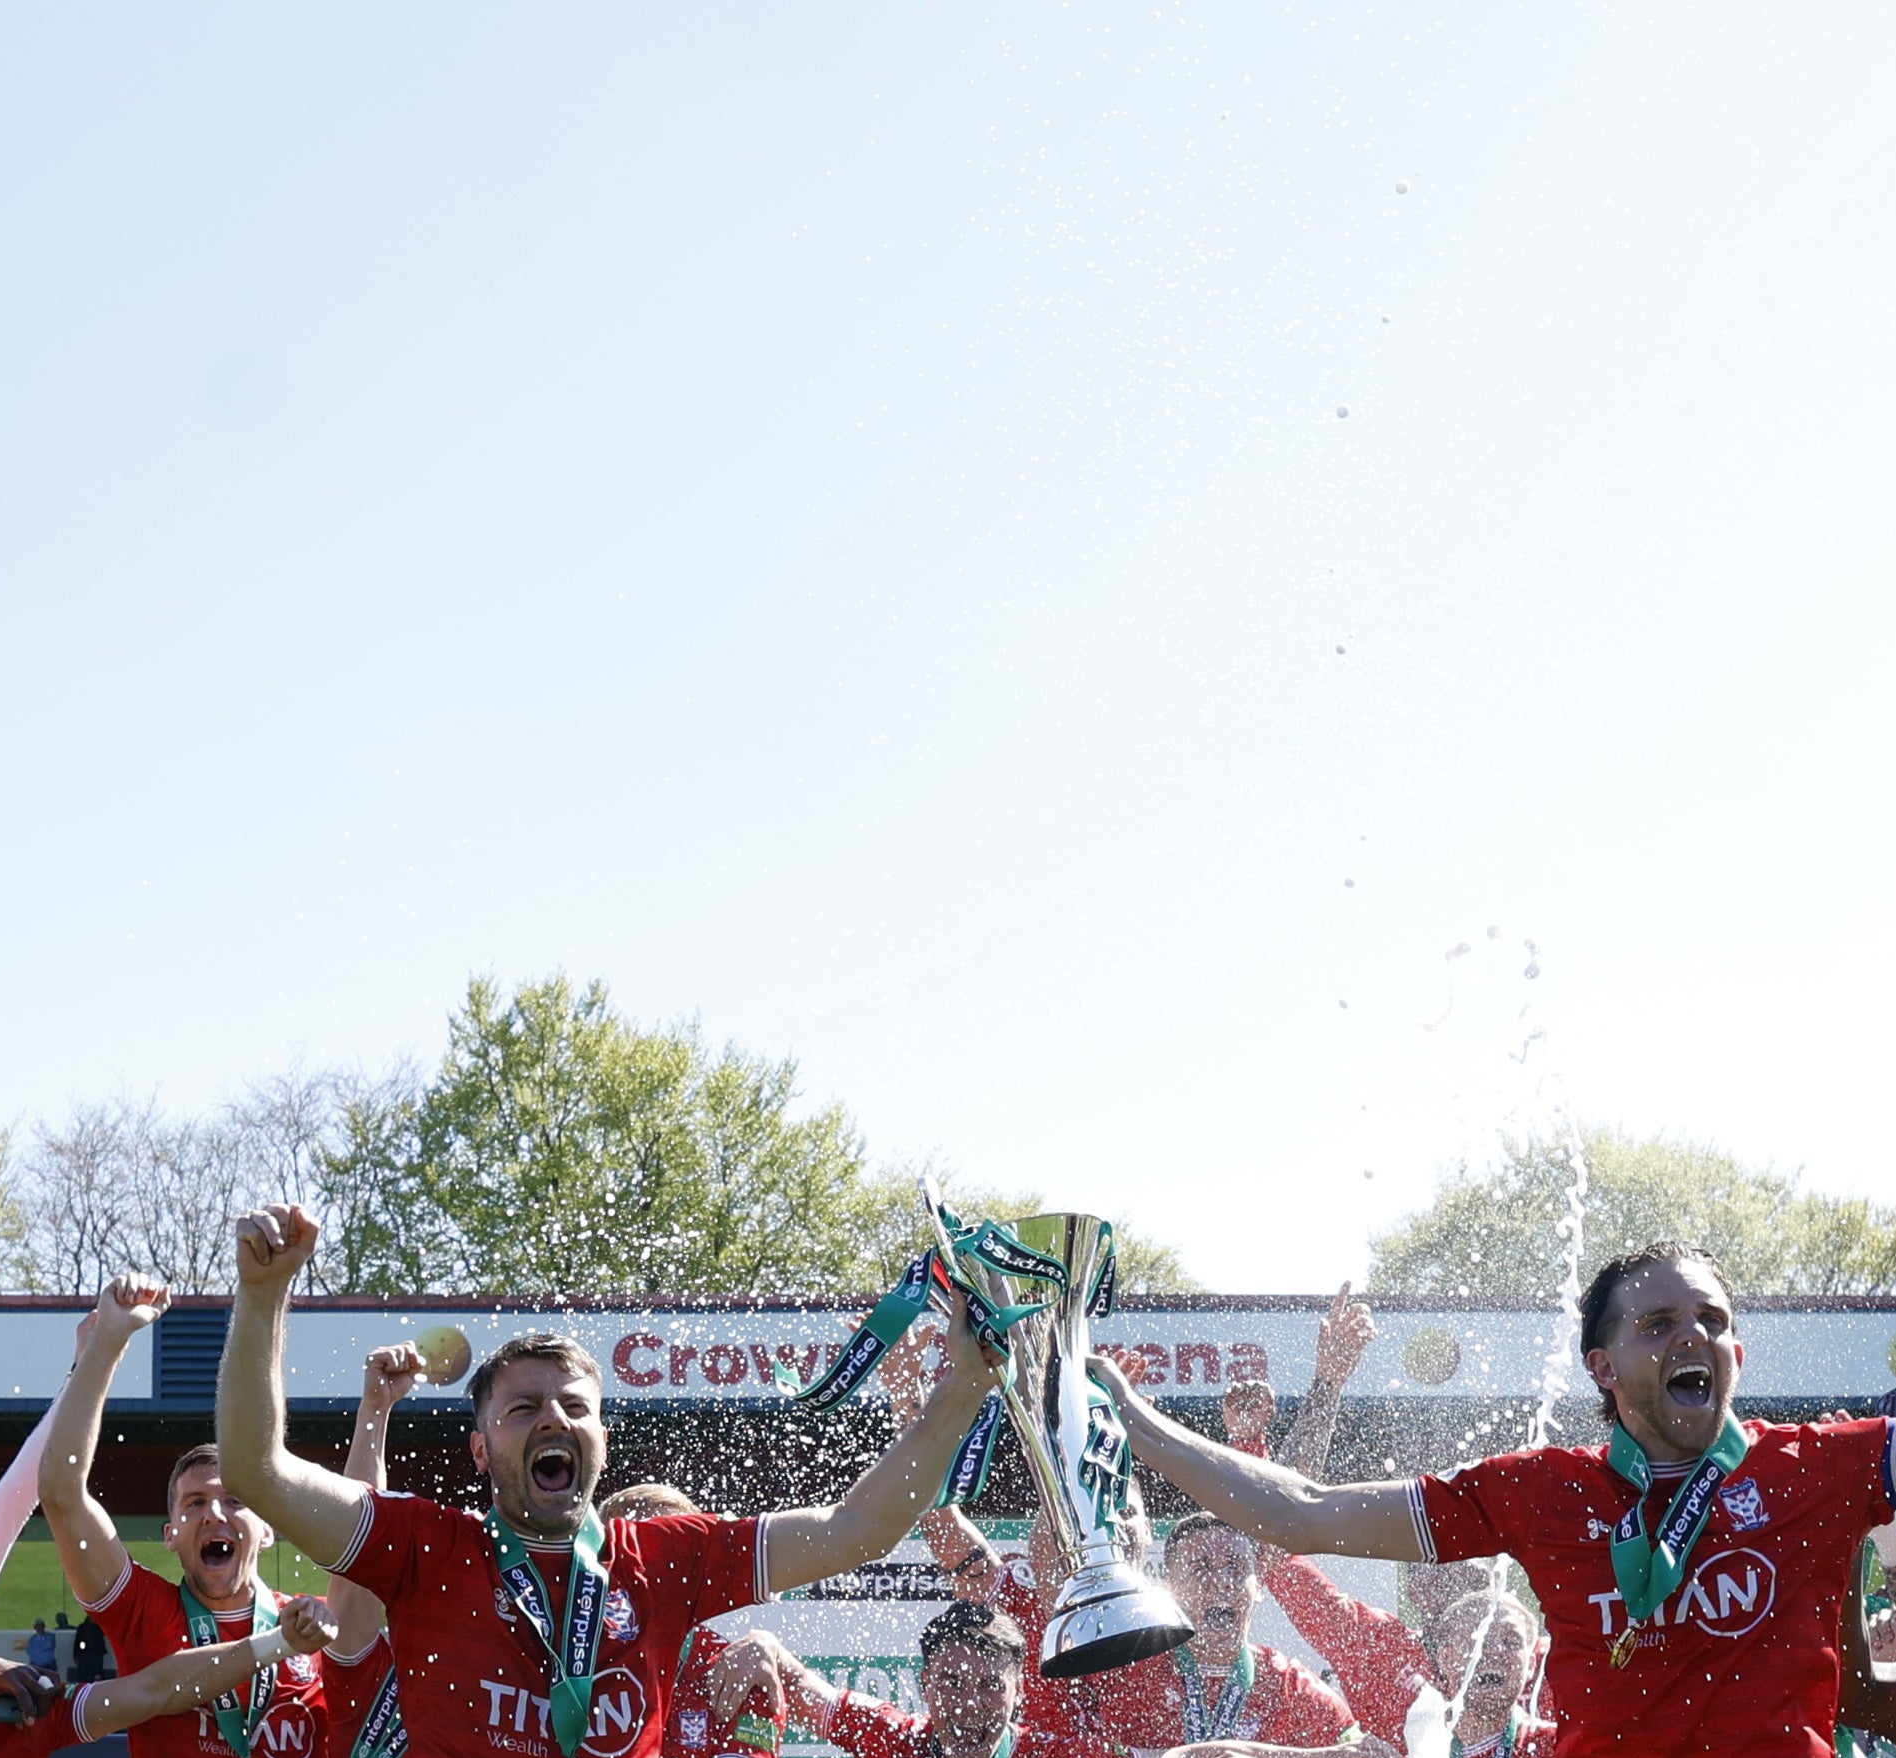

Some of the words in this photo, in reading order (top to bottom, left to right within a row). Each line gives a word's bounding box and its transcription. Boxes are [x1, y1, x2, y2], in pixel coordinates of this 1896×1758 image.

[805, 1335, 878, 1408] terprise
[1666, 1466, 1719, 1551] nterprise
[572, 1571, 596, 1675] nterprise
[480, 1679, 633, 1740] TITN
[487, 1730, 549, 1758] Wealth
